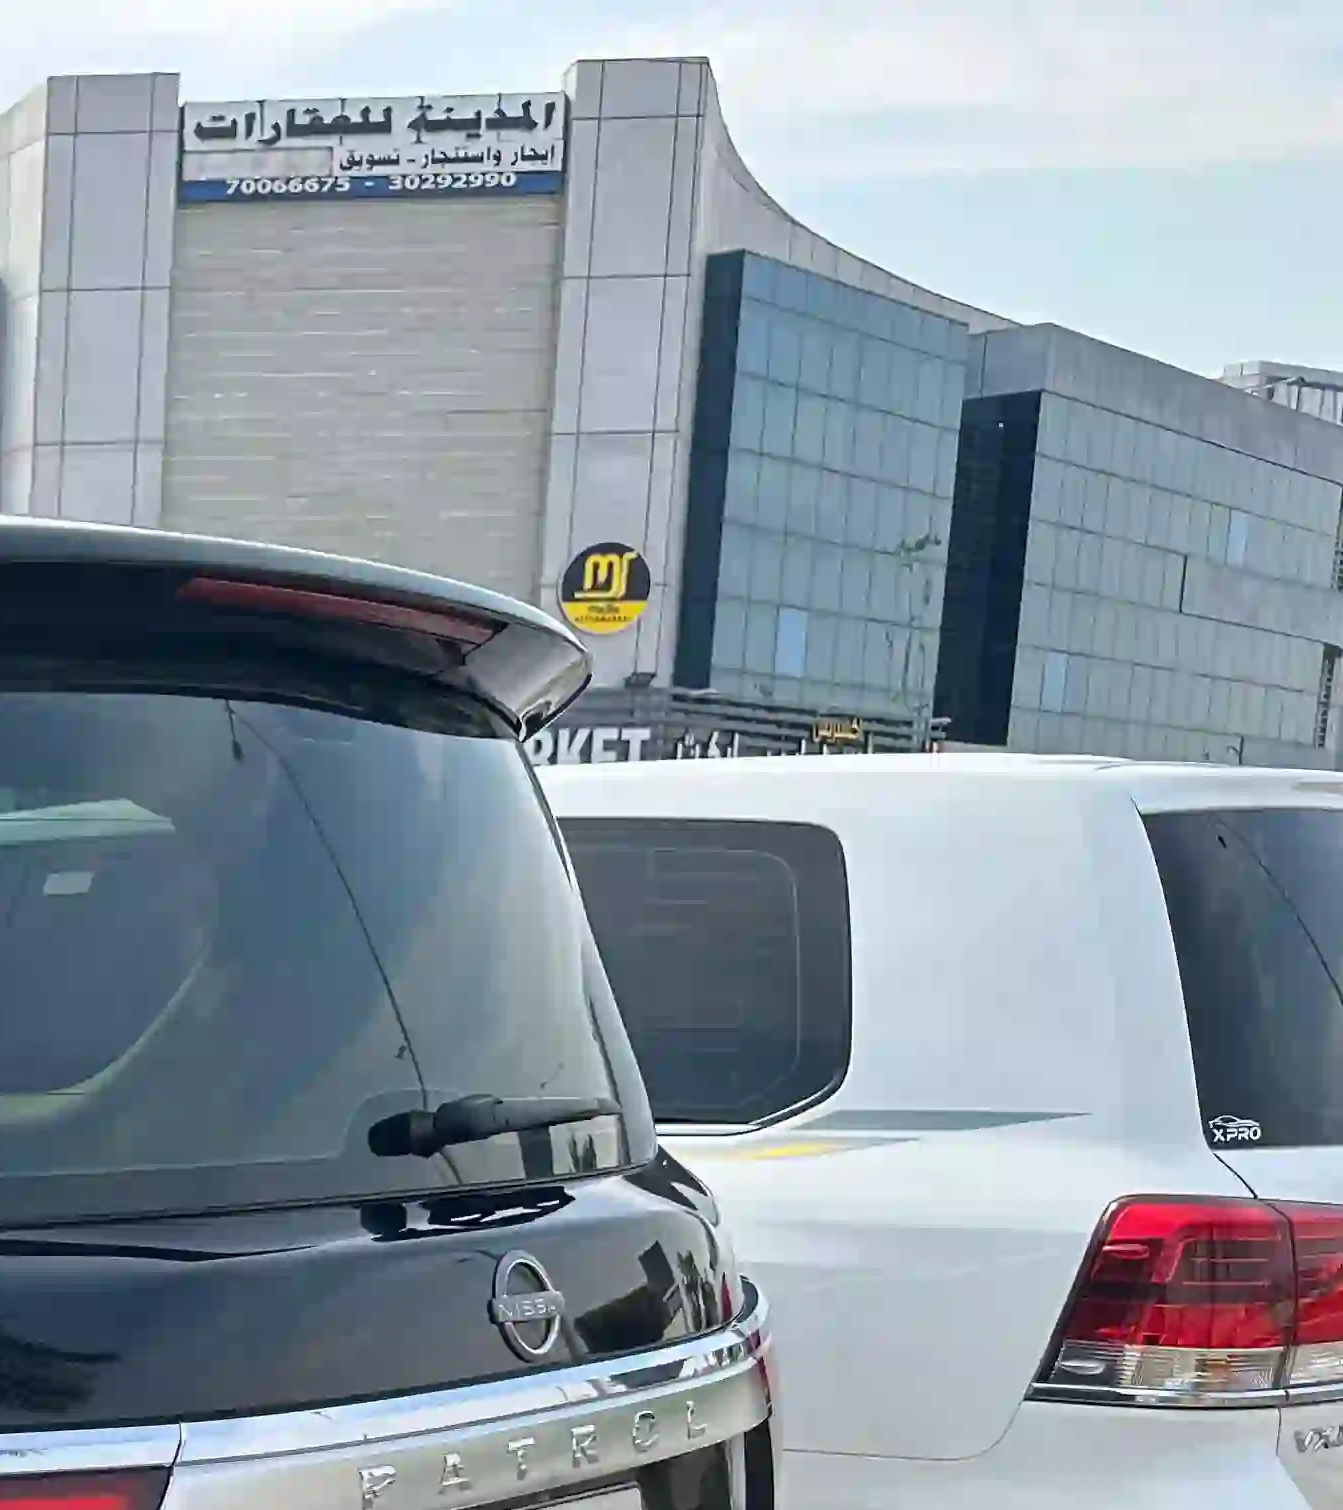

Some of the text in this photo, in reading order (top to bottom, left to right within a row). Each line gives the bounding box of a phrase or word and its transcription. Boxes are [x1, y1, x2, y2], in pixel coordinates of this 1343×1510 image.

[194, 100, 556, 147] المدينة للعقارات
[226, 177, 351, 195] 70066675
[388, 171, 517, 191] 30292990
[523, 727, 651, 766] RKET
